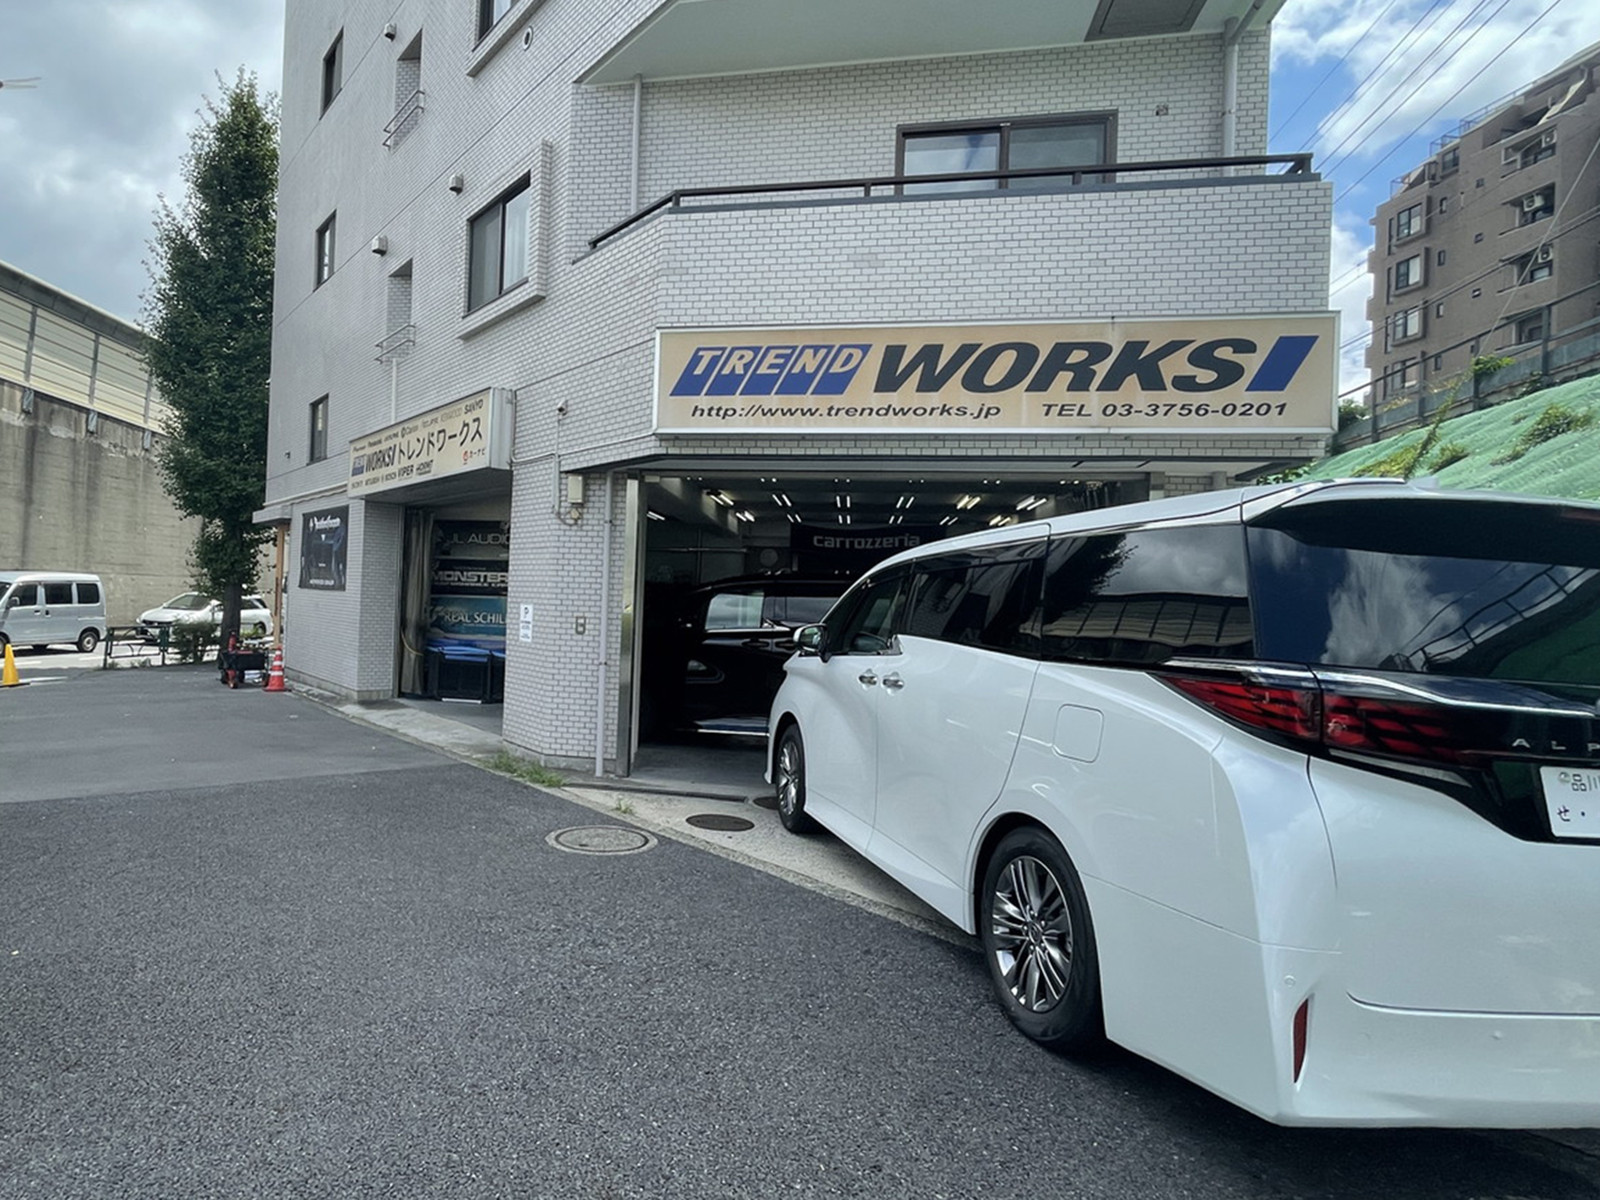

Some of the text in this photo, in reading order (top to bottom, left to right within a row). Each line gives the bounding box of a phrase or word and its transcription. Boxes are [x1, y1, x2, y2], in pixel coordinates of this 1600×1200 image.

[690, 338, 1258, 393] TREND WORKS
[691, 402, 1001, 420] http://www.trendworks.jp
[1042, 402, 1288, 417] TEL 03-3756-0201
[398, 417, 483, 465] トレンドワークス
[813, 534, 921, 549] carrozzeria
